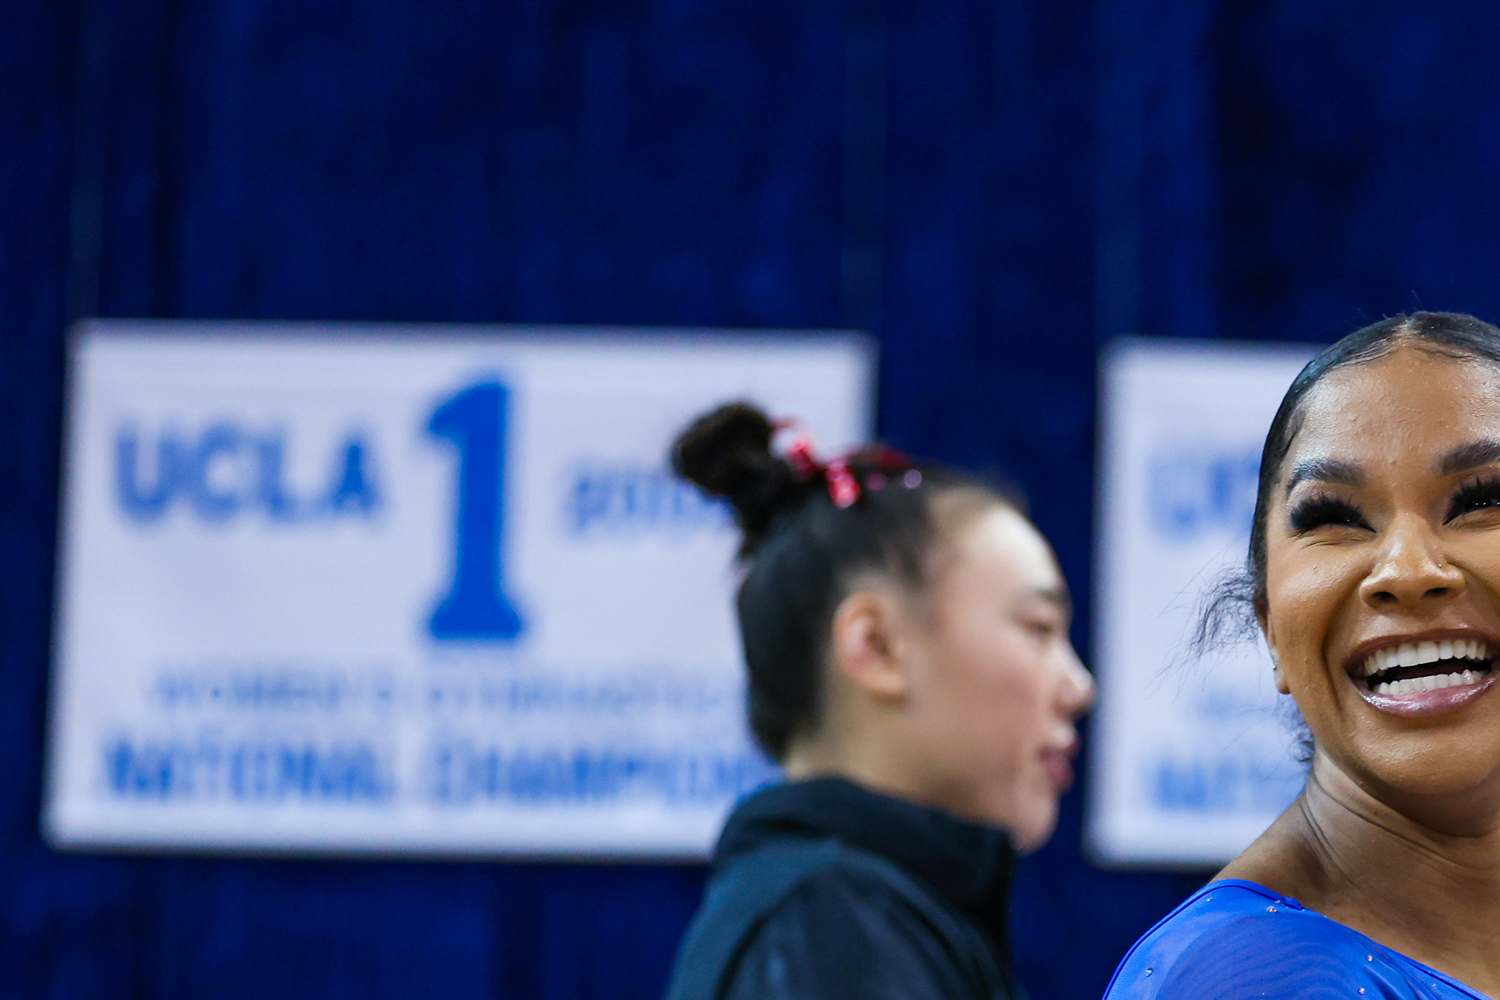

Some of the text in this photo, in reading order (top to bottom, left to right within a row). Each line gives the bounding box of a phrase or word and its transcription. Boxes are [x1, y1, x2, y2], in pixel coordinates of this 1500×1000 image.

[115, 423, 384, 524] UCLA
[424, 374, 526, 642] 1
[102, 732, 392, 802] NATIONAL
